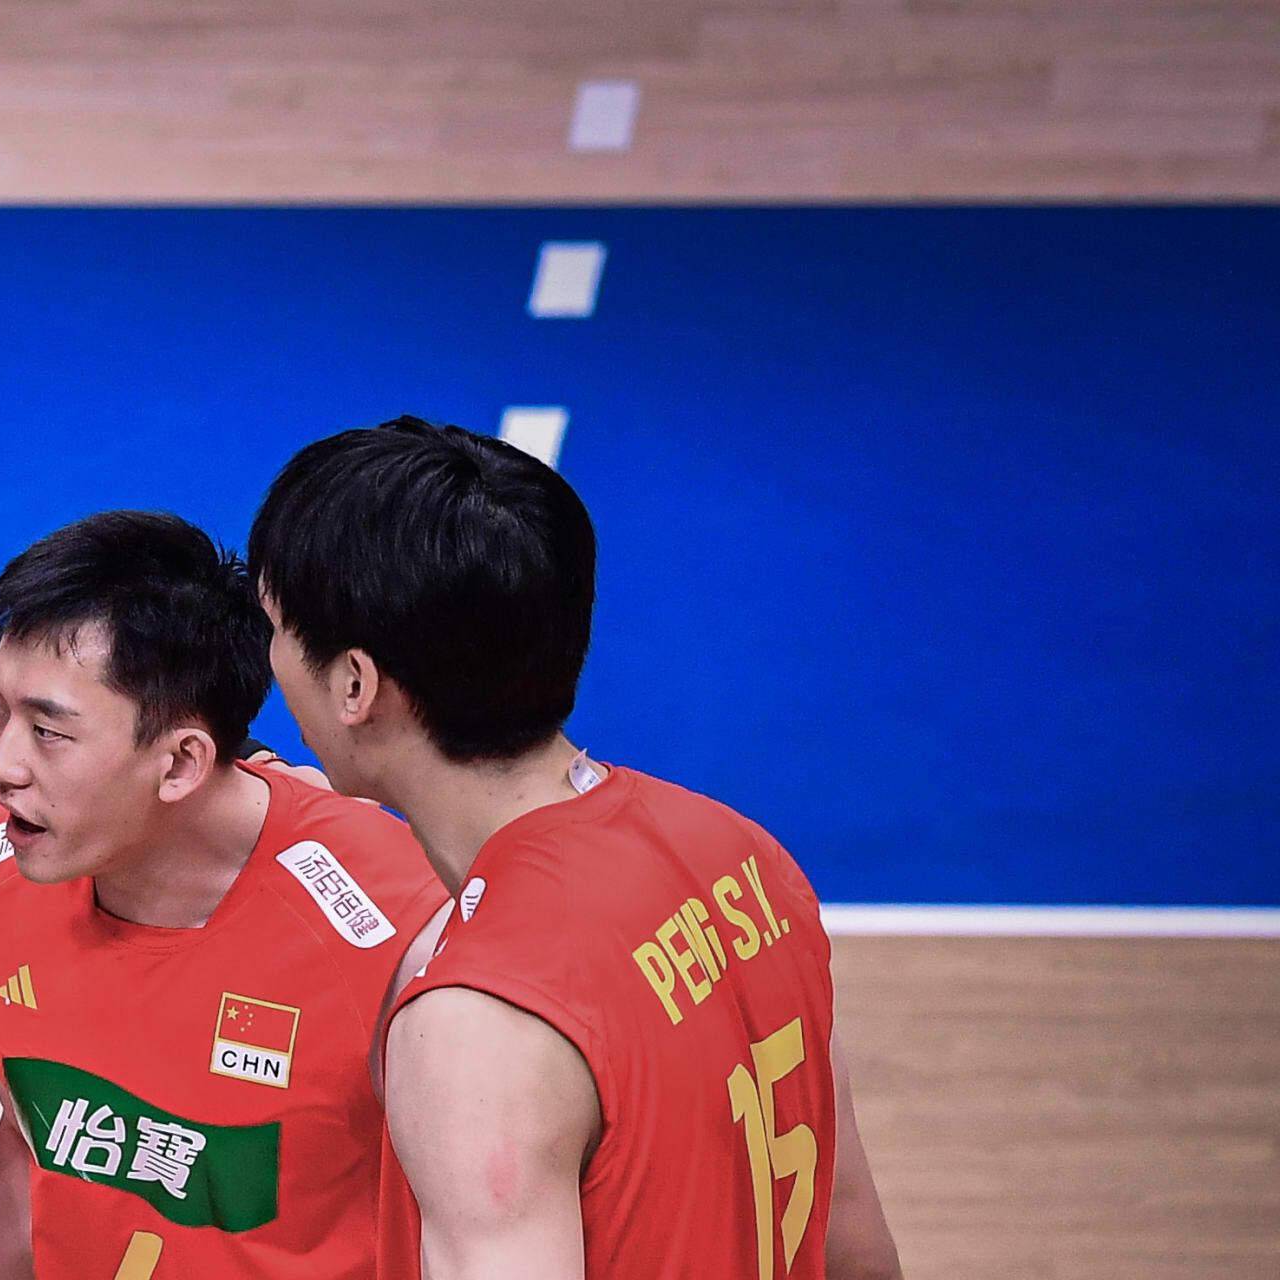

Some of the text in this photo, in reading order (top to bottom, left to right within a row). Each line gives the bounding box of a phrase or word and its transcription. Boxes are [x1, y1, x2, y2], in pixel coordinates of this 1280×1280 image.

[294, 849, 381, 942] 汤臣倍健
[712, 854, 791, 962] S.Y.
[220, 1049, 282, 1080] CHN
[46, 1097, 207, 1200] 怡寶
